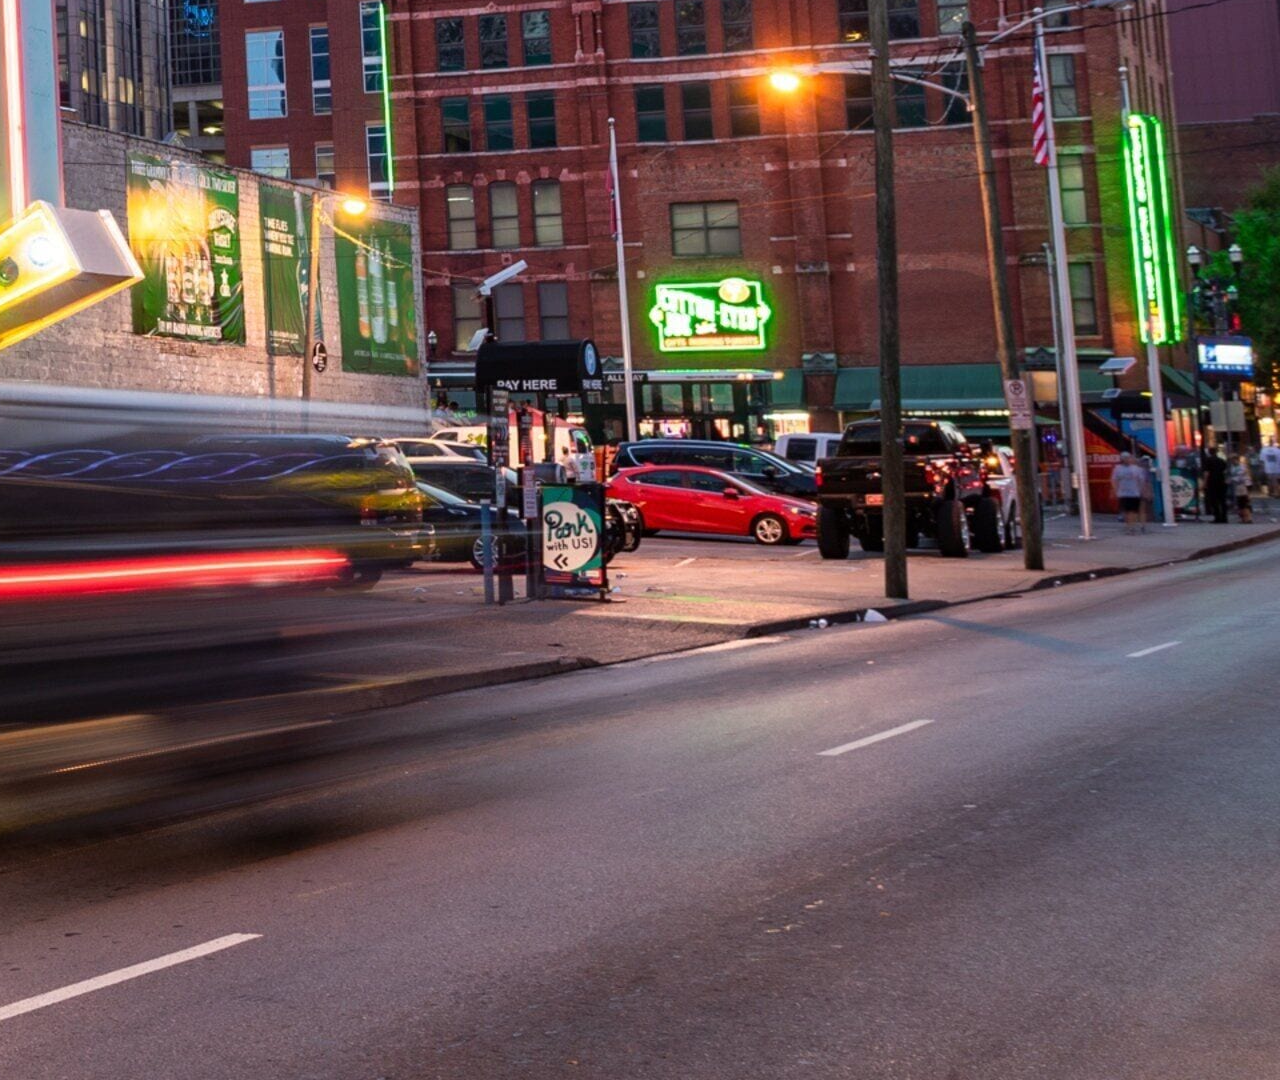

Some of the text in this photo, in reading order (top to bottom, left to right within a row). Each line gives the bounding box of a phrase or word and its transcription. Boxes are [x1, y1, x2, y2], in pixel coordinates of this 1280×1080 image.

[497, 379, 557, 390] PAY HERE
[544, 510, 593, 542] Park
[547, 537, 593, 551] with US!
